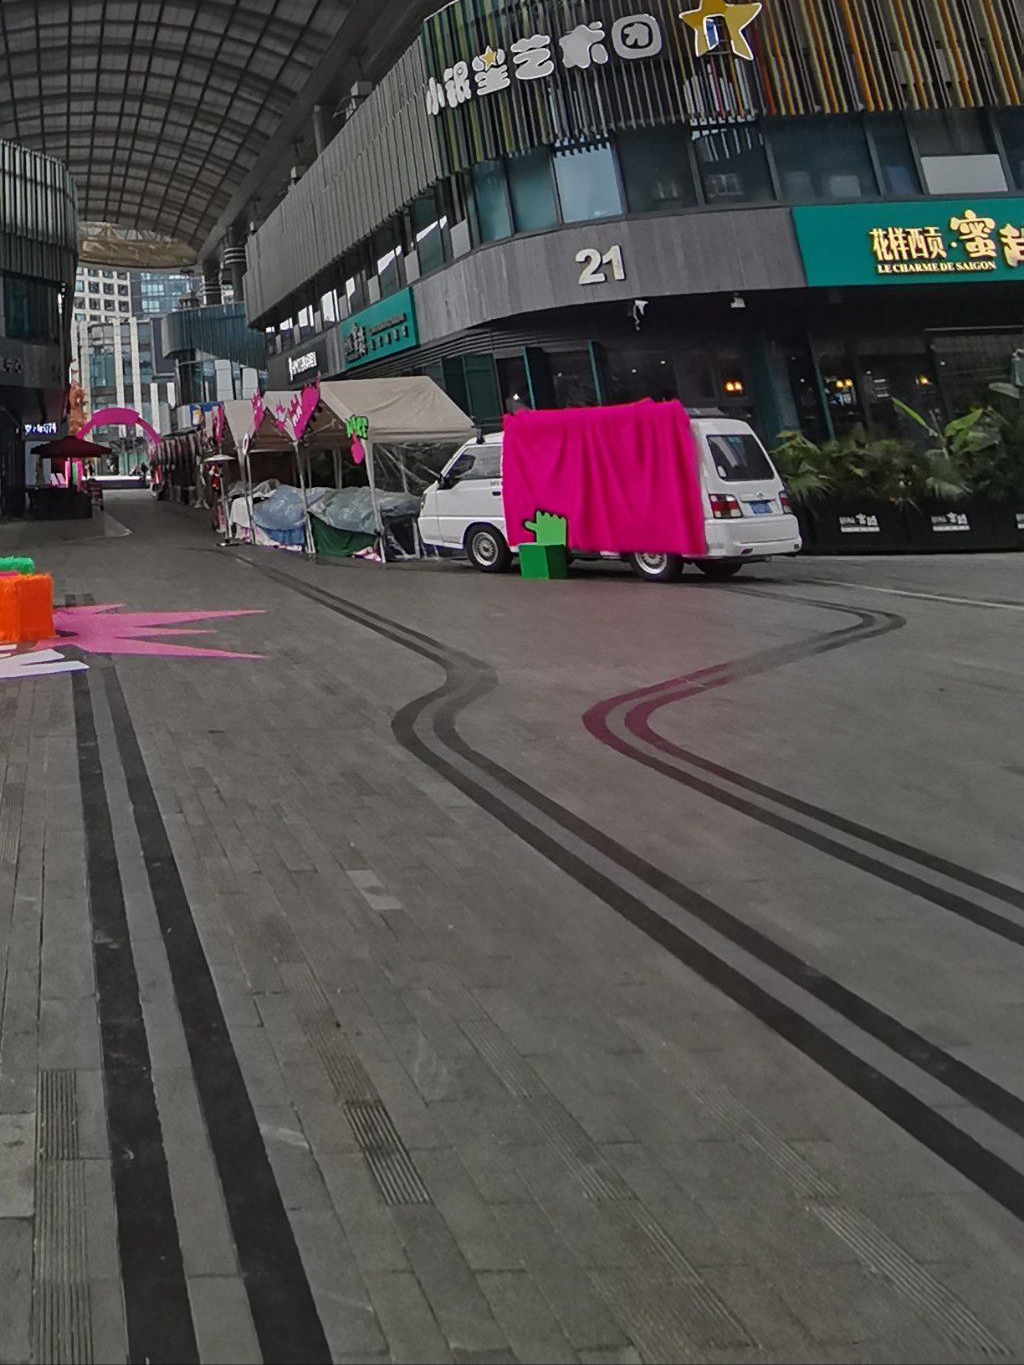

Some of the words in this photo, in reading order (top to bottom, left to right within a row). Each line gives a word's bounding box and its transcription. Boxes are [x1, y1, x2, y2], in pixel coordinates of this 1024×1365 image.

[575, 245, 625, 284] 21
[877, 264, 892, 273] LE
[892, 262, 939, 273] CHARME
[940, 262, 955, 271] DE
[956, 261, 997, 271] SAIGON
